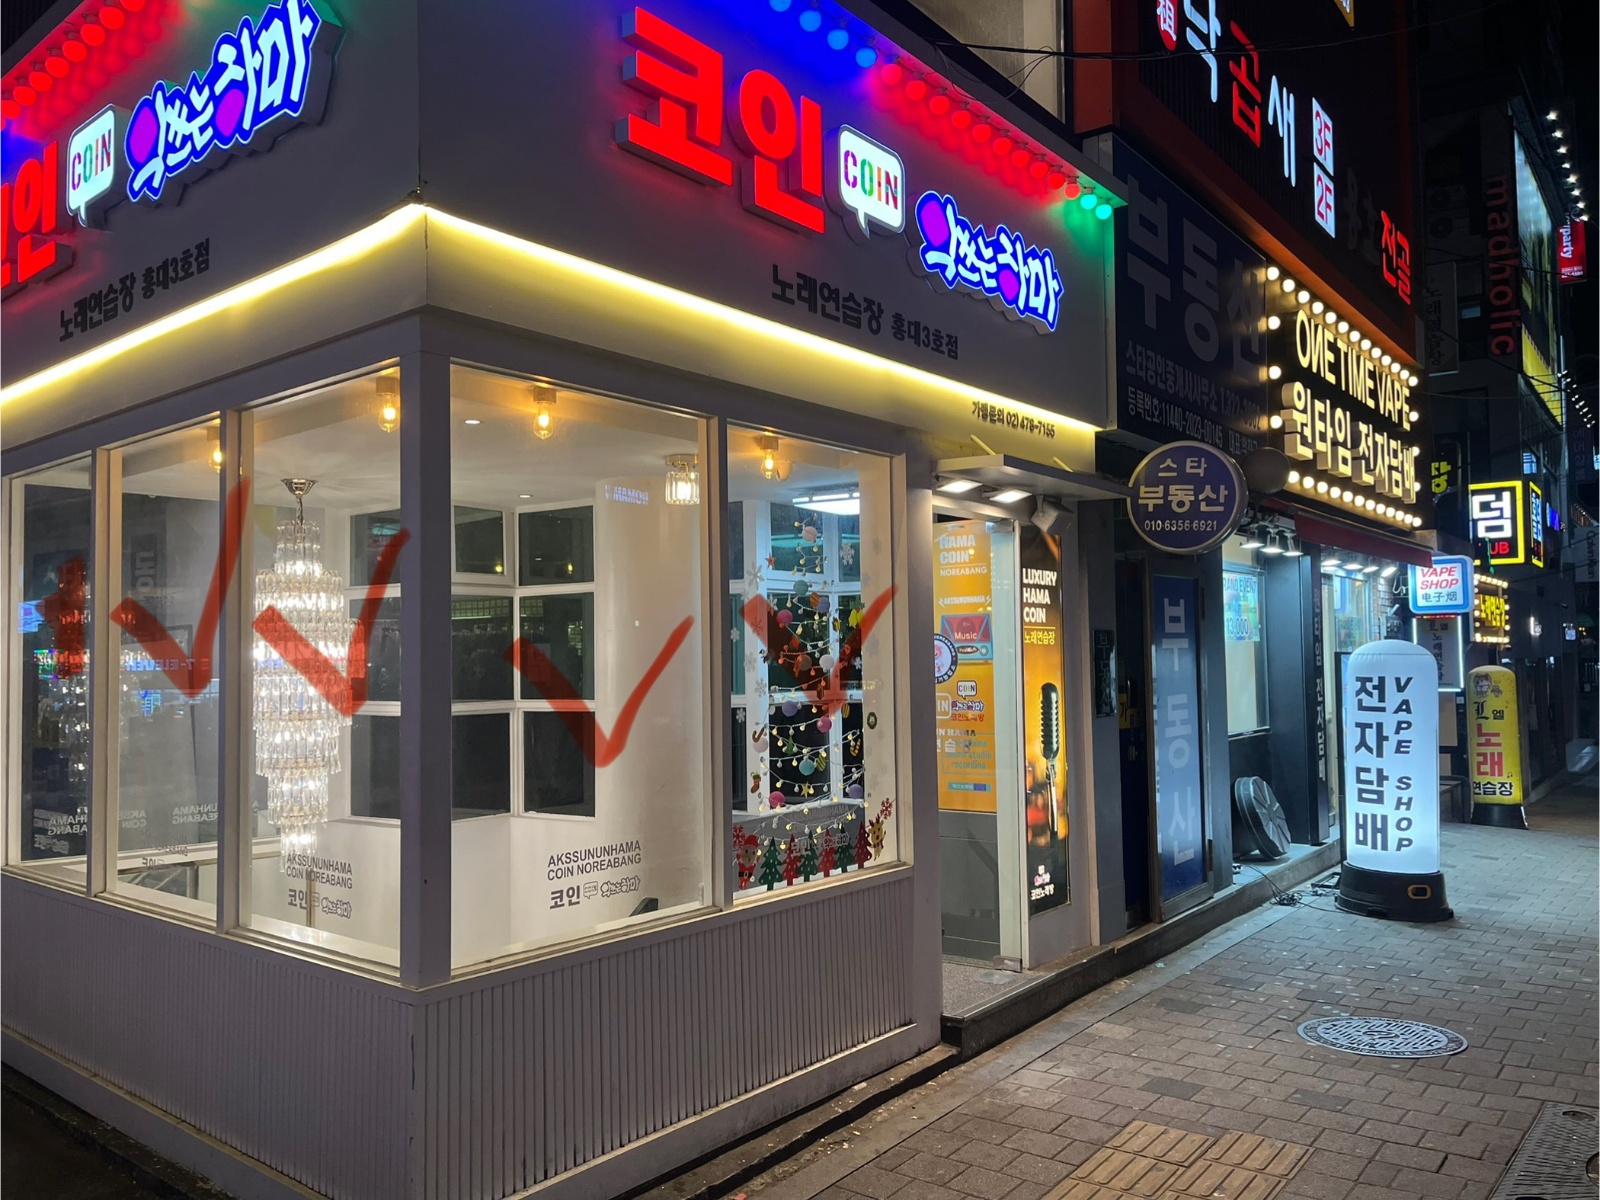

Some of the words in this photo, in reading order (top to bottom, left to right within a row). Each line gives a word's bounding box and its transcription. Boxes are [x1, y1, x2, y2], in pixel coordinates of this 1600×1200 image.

[622, 5, 825, 235] 코인
[1313, 108, 1333, 157] 3F
[71, 128, 112, 192] COIN
[843, 149, 899, 210] COIN
[1315, 173, 1334, 226] 2F
[0, 141, 58, 288] 인
[59, 271, 135, 342] 노래연습장
[142, 238, 211, 299] 홍대3호점
[1127, 174, 1261, 387] 부동산
[771, 263, 884, 336] 노래연습장
[891, 311, 960, 361] 홍대3호점
[1296, 309, 1335, 385] ONE
[1336, 336, 1376, 407] TIME
[1375, 365, 1411, 431] VAPE
[1284, 381, 1352, 478] 원타임
[1355, 421, 1417, 504] 전자담배
[1158, 457, 1208, 477] 스타
[1138, 484, 1229, 514] 부동산
[1472, 490, 1512, 539] 덤
[939, 534, 976, 549] HAMA
[939, 550, 970, 564] COIN
[940, 566, 988, 577] NOREABANG
[1022, 567, 1058, 586] LUXURY
[1420, 578, 1459, 590] SHOP
[1421, 565, 1457, 578] VAPE
[1023, 587, 1051, 605] HAMA
[1421, 591, 1458, 603] 电子烟
[1023, 606, 1046, 623] COIN
[954, 631, 978, 640] Music
[1024, 627, 1056, 646] 노래연습장
[1392, 676, 1414, 755] VAPE
[1473, 700, 1490, 721] L
[1160, 597, 1195, 867] 부동산
[1354, 675, 1390, 852] 전자담배
[1476, 722, 1504, 777] 노래
[1473, 781, 1514, 797] 연습장
[1394, 775, 1414, 852] SHOP
[286, 853, 353, 876] AKSSUNUNHAMA
[547, 840, 641, 868] AKSSUNUNHAMA
[547, 865, 574, 881] COIN
[576, 853, 642, 876] NOREABANG
[286, 866, 304, 880] COIN
[305, 868, 353, 889] NOREABANG
[549, 885, 581, 910] 코인
